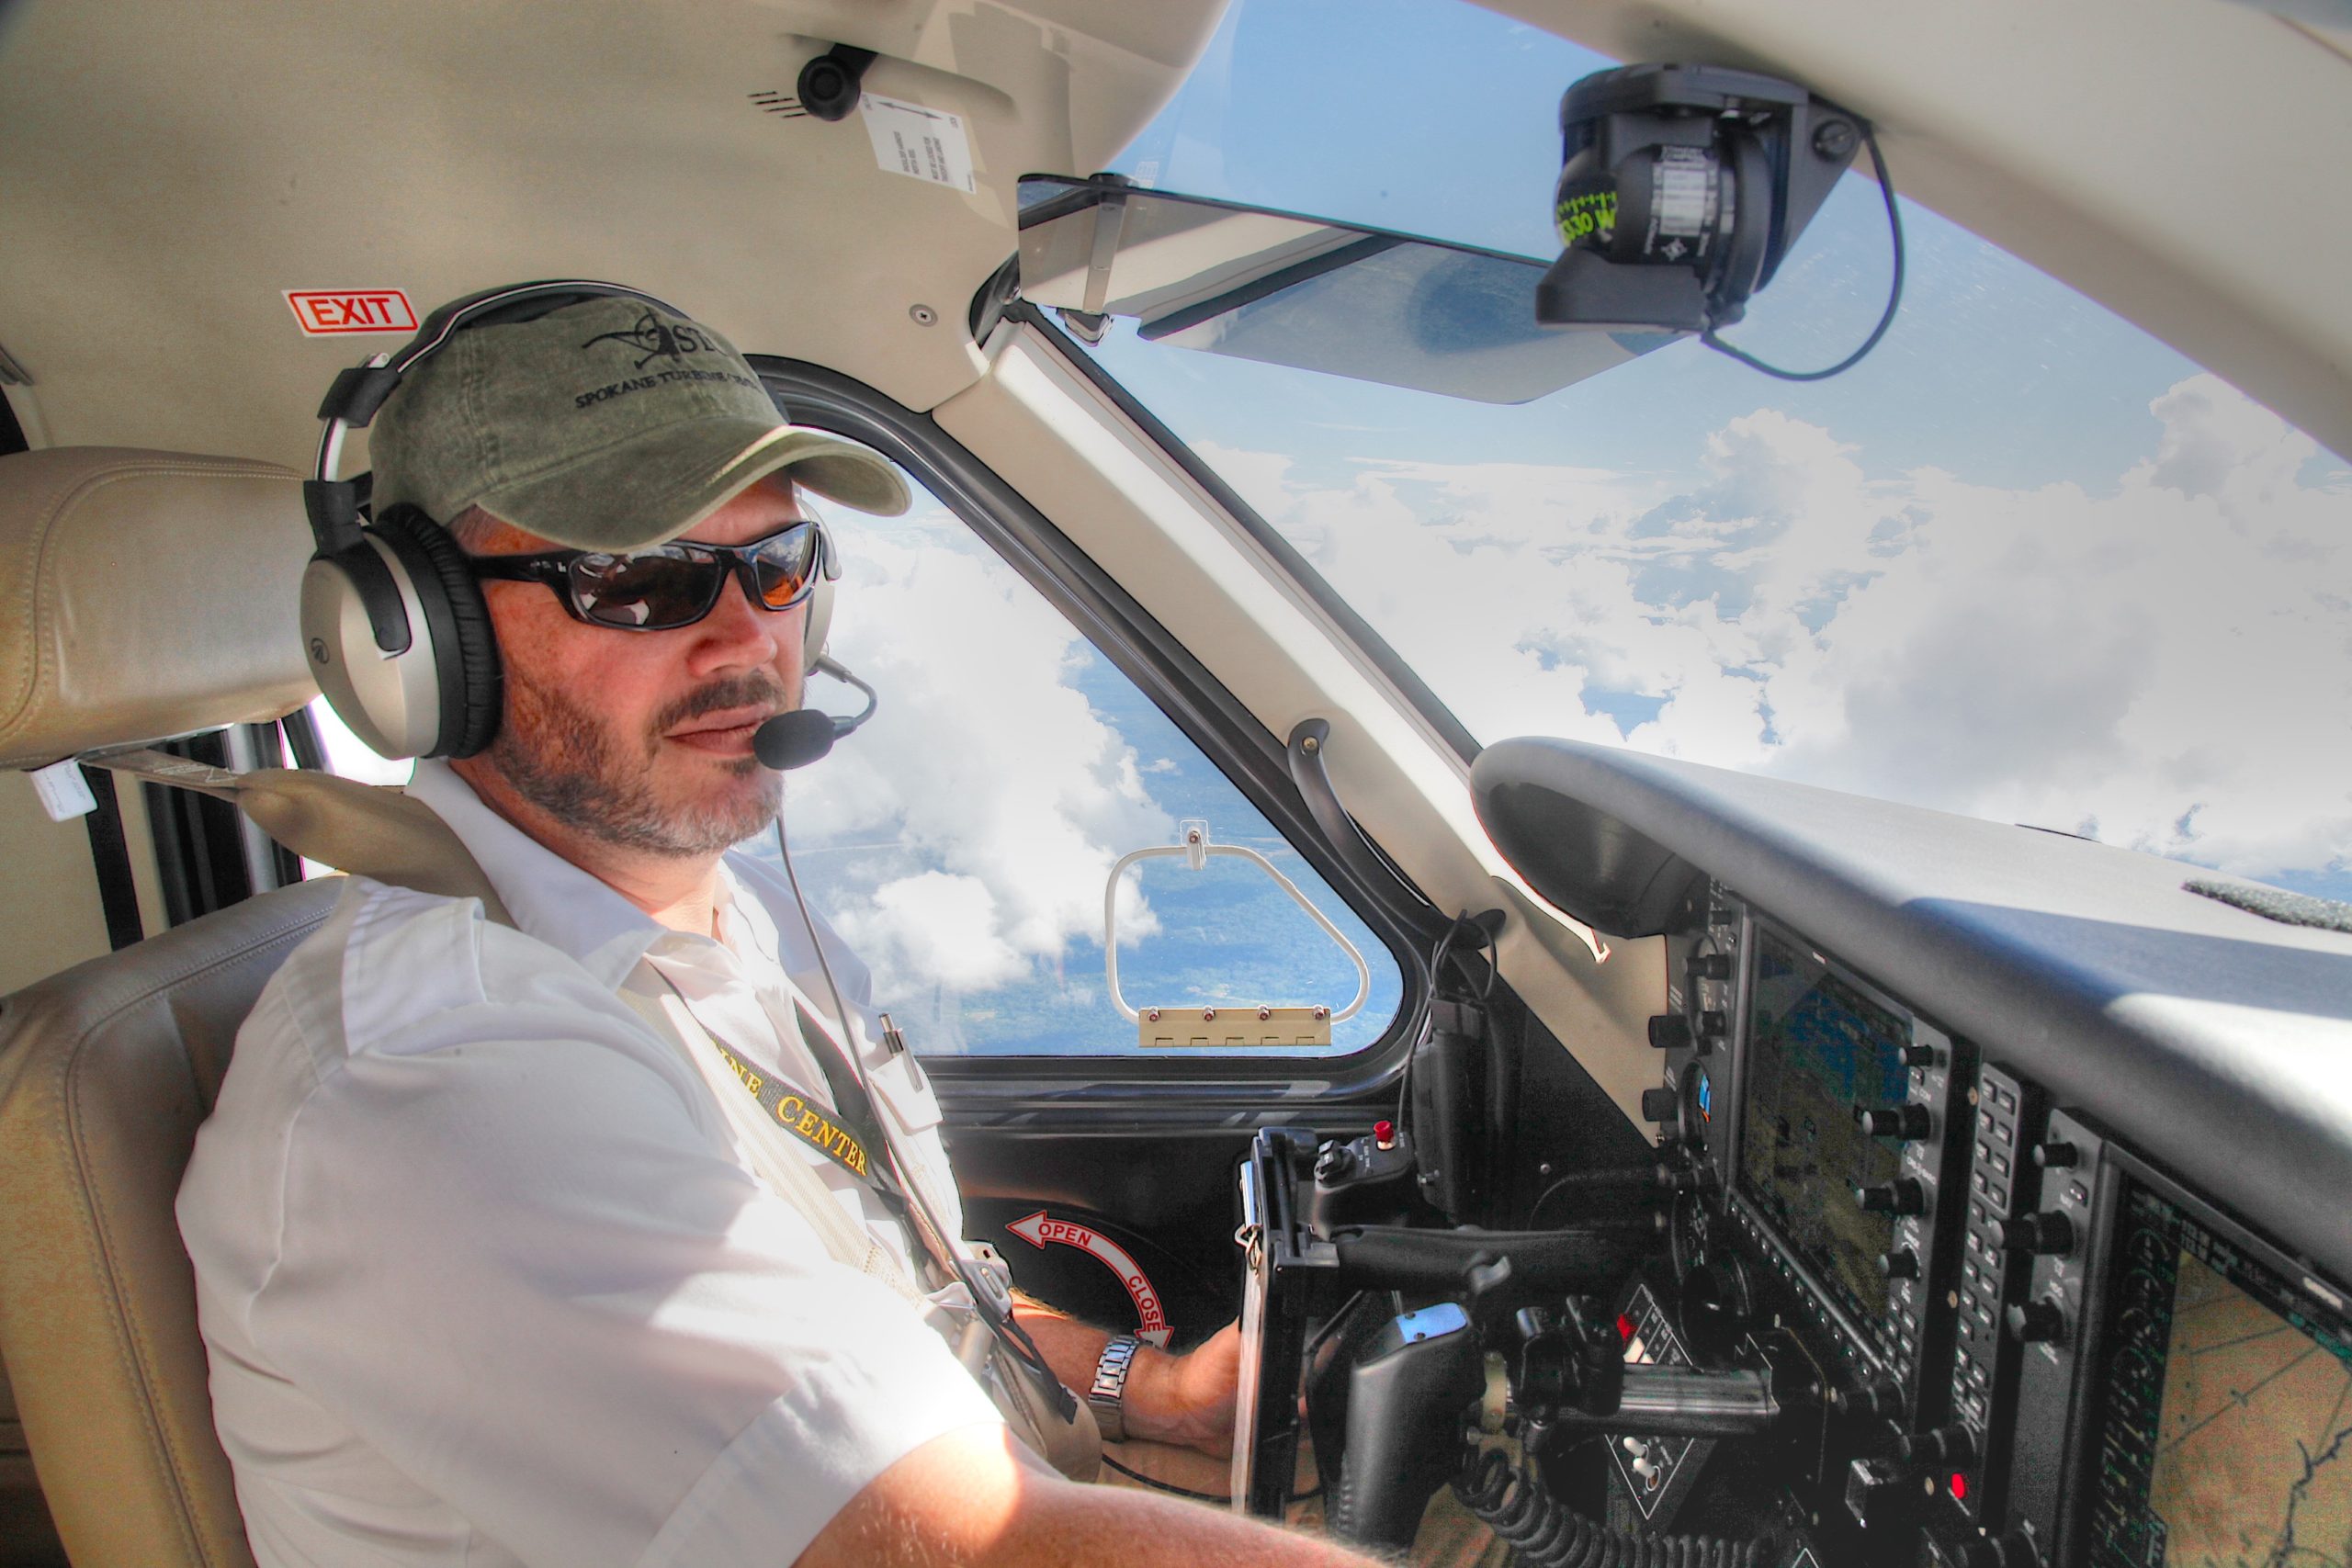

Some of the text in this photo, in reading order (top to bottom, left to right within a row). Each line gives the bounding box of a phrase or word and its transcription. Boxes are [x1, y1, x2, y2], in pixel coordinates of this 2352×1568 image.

[307, 298, 391, 325] EXIT
[574, 376, 657, 410] SPOKANE
[775, 1094, 868, 1178] CENTER
[1038, 1223, 1091, 1247] OPEN
[1128, 1275, 1161, 1333] CLOSE
